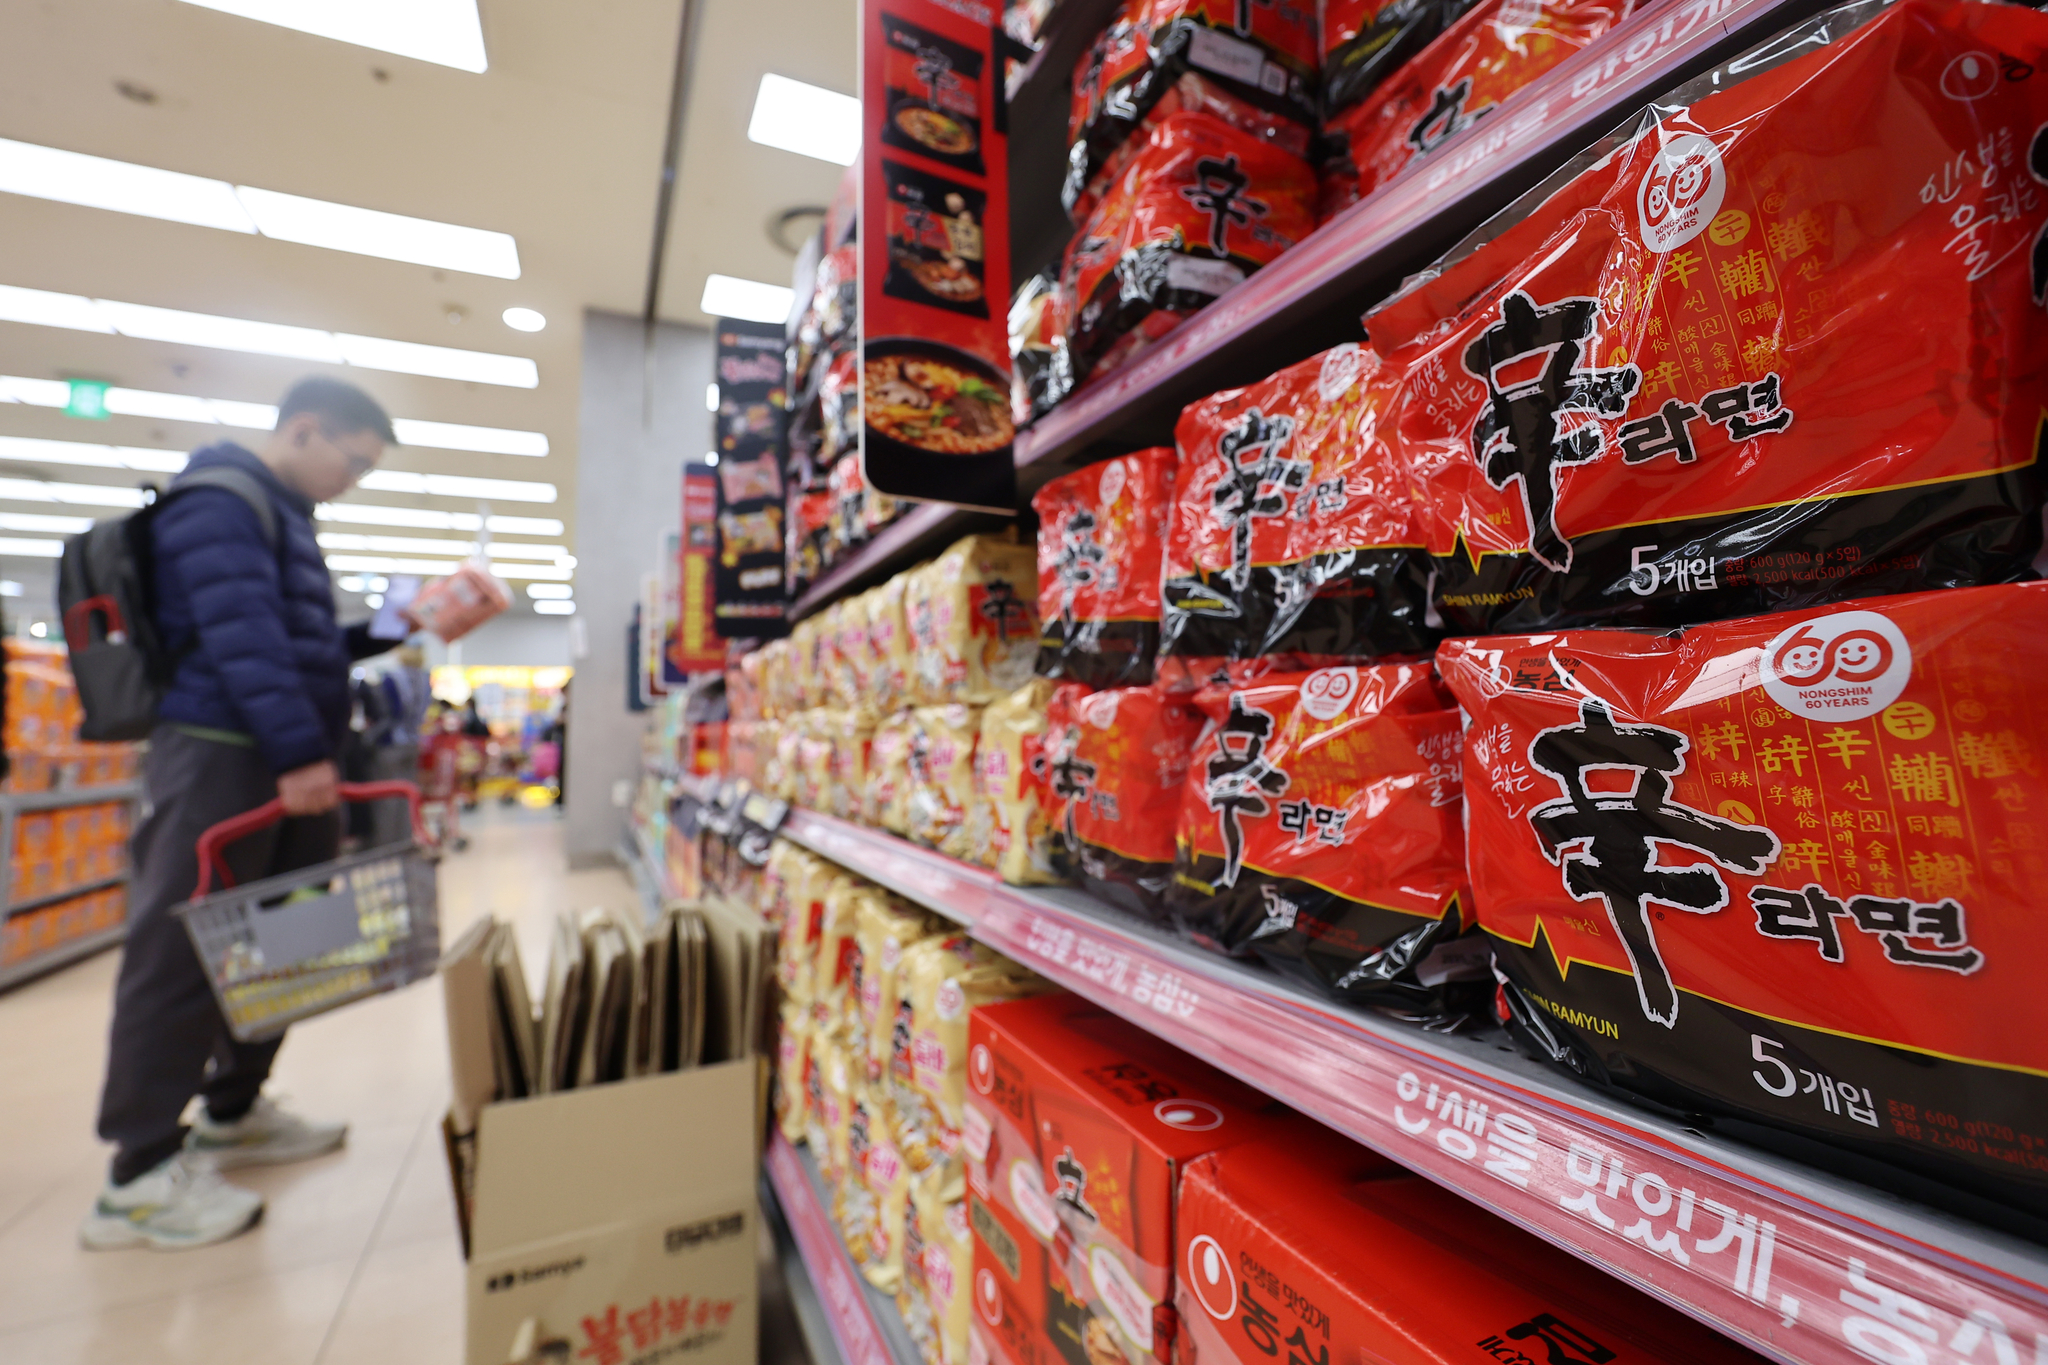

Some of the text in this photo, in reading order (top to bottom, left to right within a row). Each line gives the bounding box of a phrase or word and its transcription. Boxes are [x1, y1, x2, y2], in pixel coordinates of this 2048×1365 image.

[1662, 251, 1702, 289] 辛
[1621, 373, 1793, 464] 라면
[1629, 544, 1718, 597] 5개입
[1472, 586, 1535, 607] RAMYUN
[1799, 686, 1873, 700] NONGSHIM
[1805, 697, 1870, 709] 60 YEARS
[1817, 727, 1872, 769] 辛
[1528, 697, 1985, 1029] 辛 라면
[1551, 1001, 1619, 1040] RAMYUN
[1751, 1033, 1879, 1128] 5개입
[1393, 1070, 1540, 1189] 인생을
[1240, 1251, 1330, 1341] 인생을 맛있게
